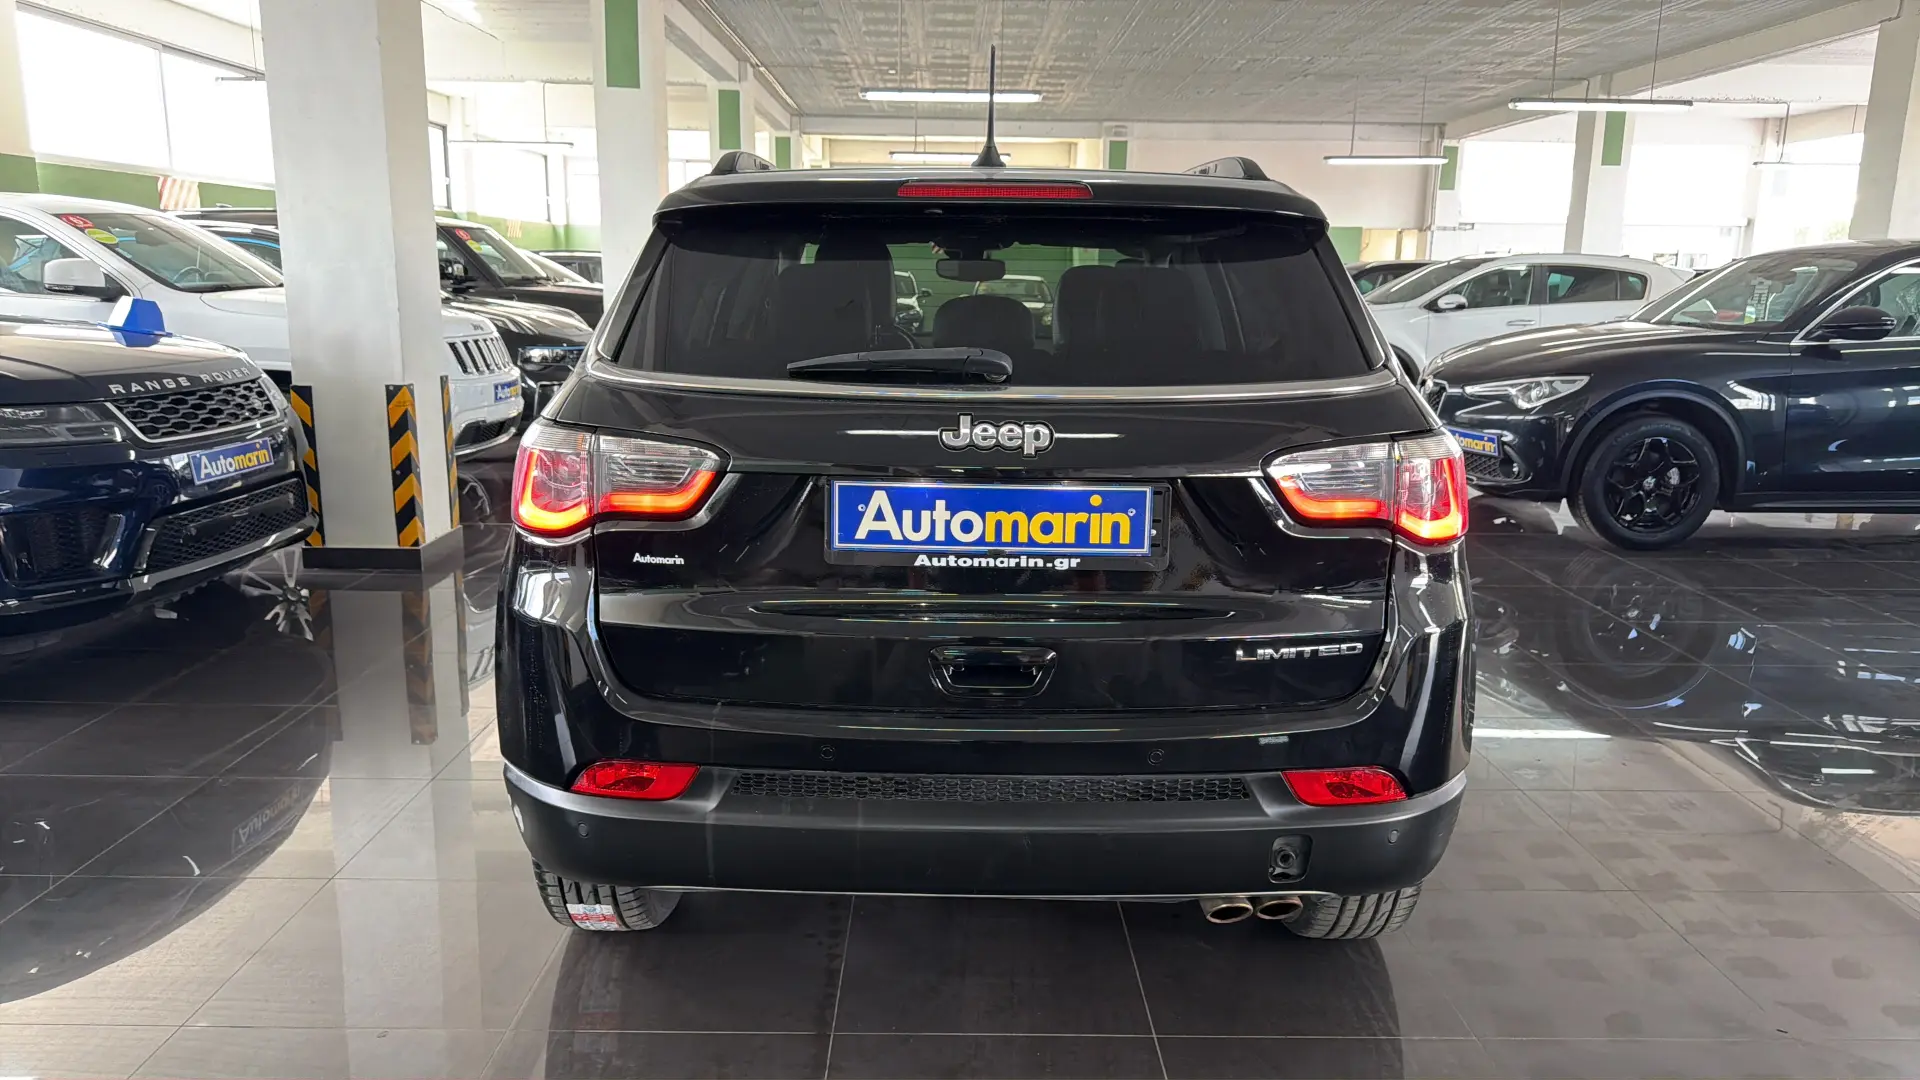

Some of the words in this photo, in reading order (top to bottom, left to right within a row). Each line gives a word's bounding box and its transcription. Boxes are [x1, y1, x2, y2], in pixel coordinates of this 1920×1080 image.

[108, 376, 191, 395] RANGE
[200, 366, 250, 384] ROVER
[940, 413, 1053, 458] Jeep
[200, 443, 270, 479] Automarin
[854, 490, 1131, 545] Automarin
[632, 552, 685, 565] Automarin
[914, 554, 1082, 571] Automarin.gr
[1236, 642, 1364, 662] LIMITED
